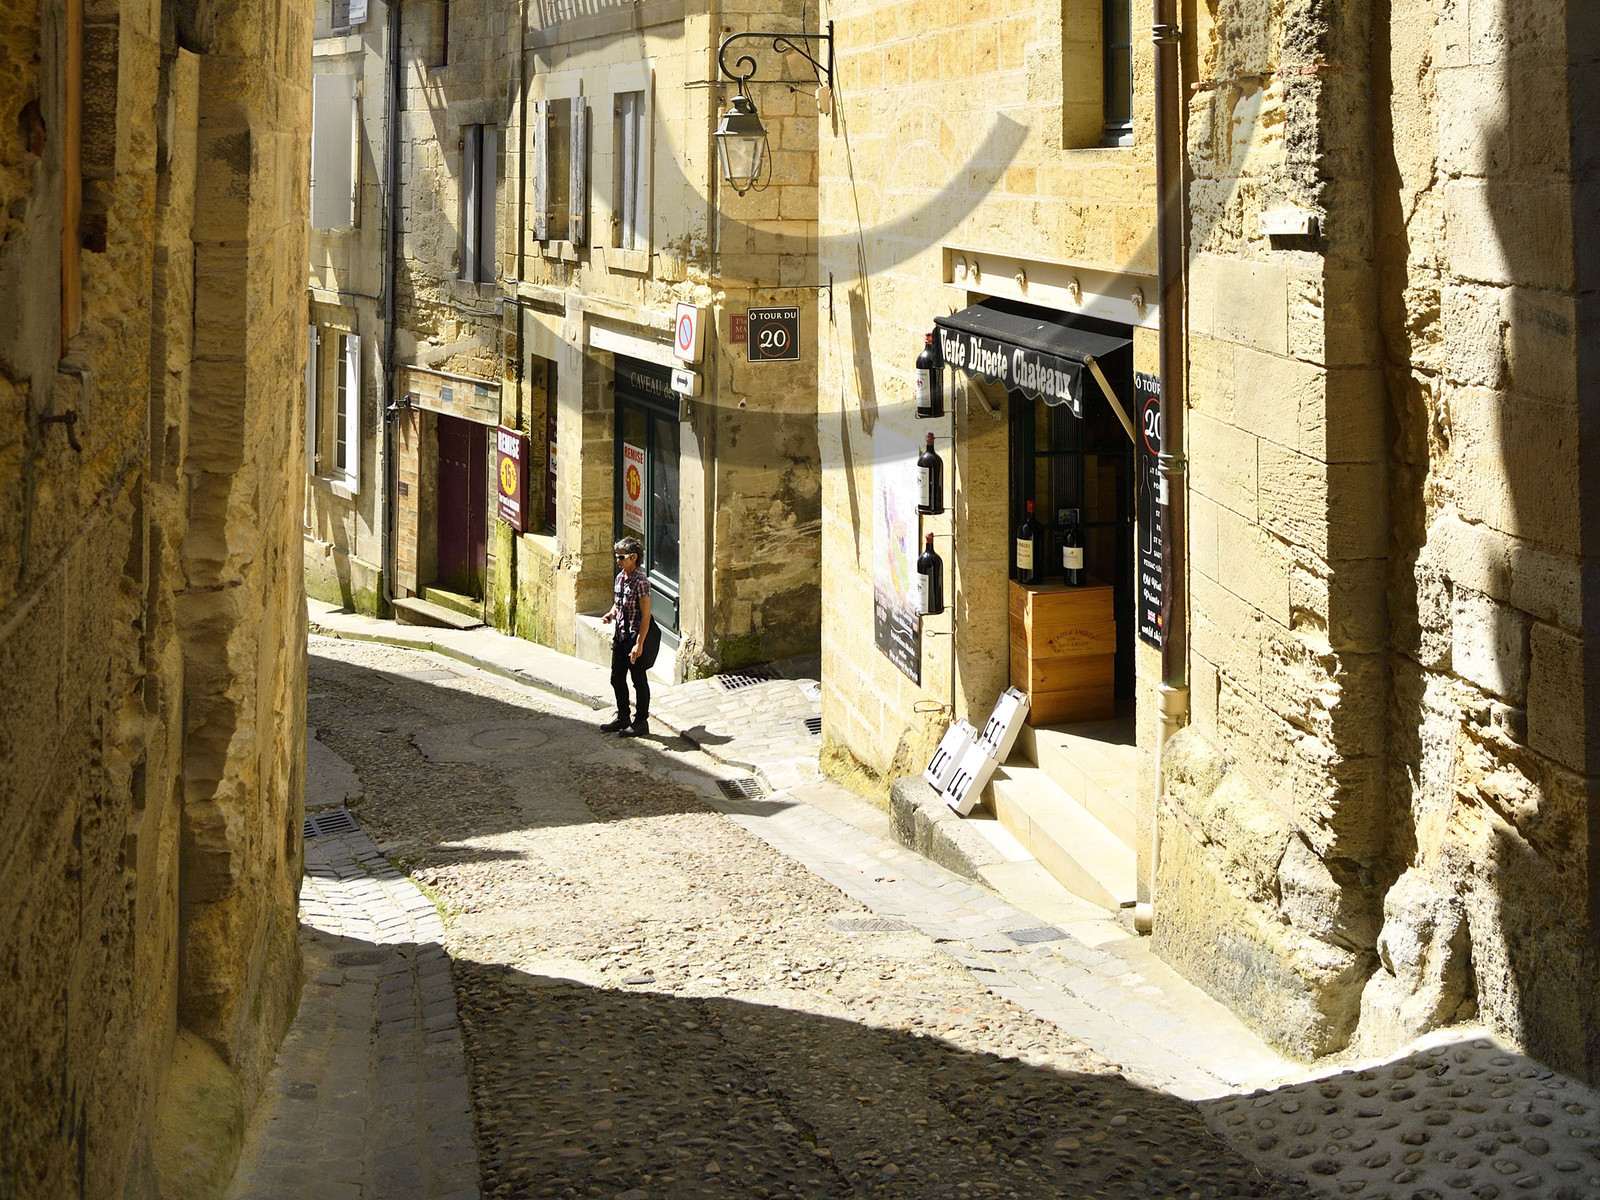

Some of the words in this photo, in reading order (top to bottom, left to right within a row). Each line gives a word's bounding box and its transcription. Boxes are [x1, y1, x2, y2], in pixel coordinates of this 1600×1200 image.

[750, 312, 757, 320] Ô
[760, 330, 786, 348] 20
[968, 337, 1008, 380] Directe
[1012, 348, 1072, 401] Chateaux
[630, 371, 662, 396] CAVEAU
[663, 382, 676, 400] des
[498, 430, 520, 460] REMISE
[624, 445, 644, 465] REMISE
